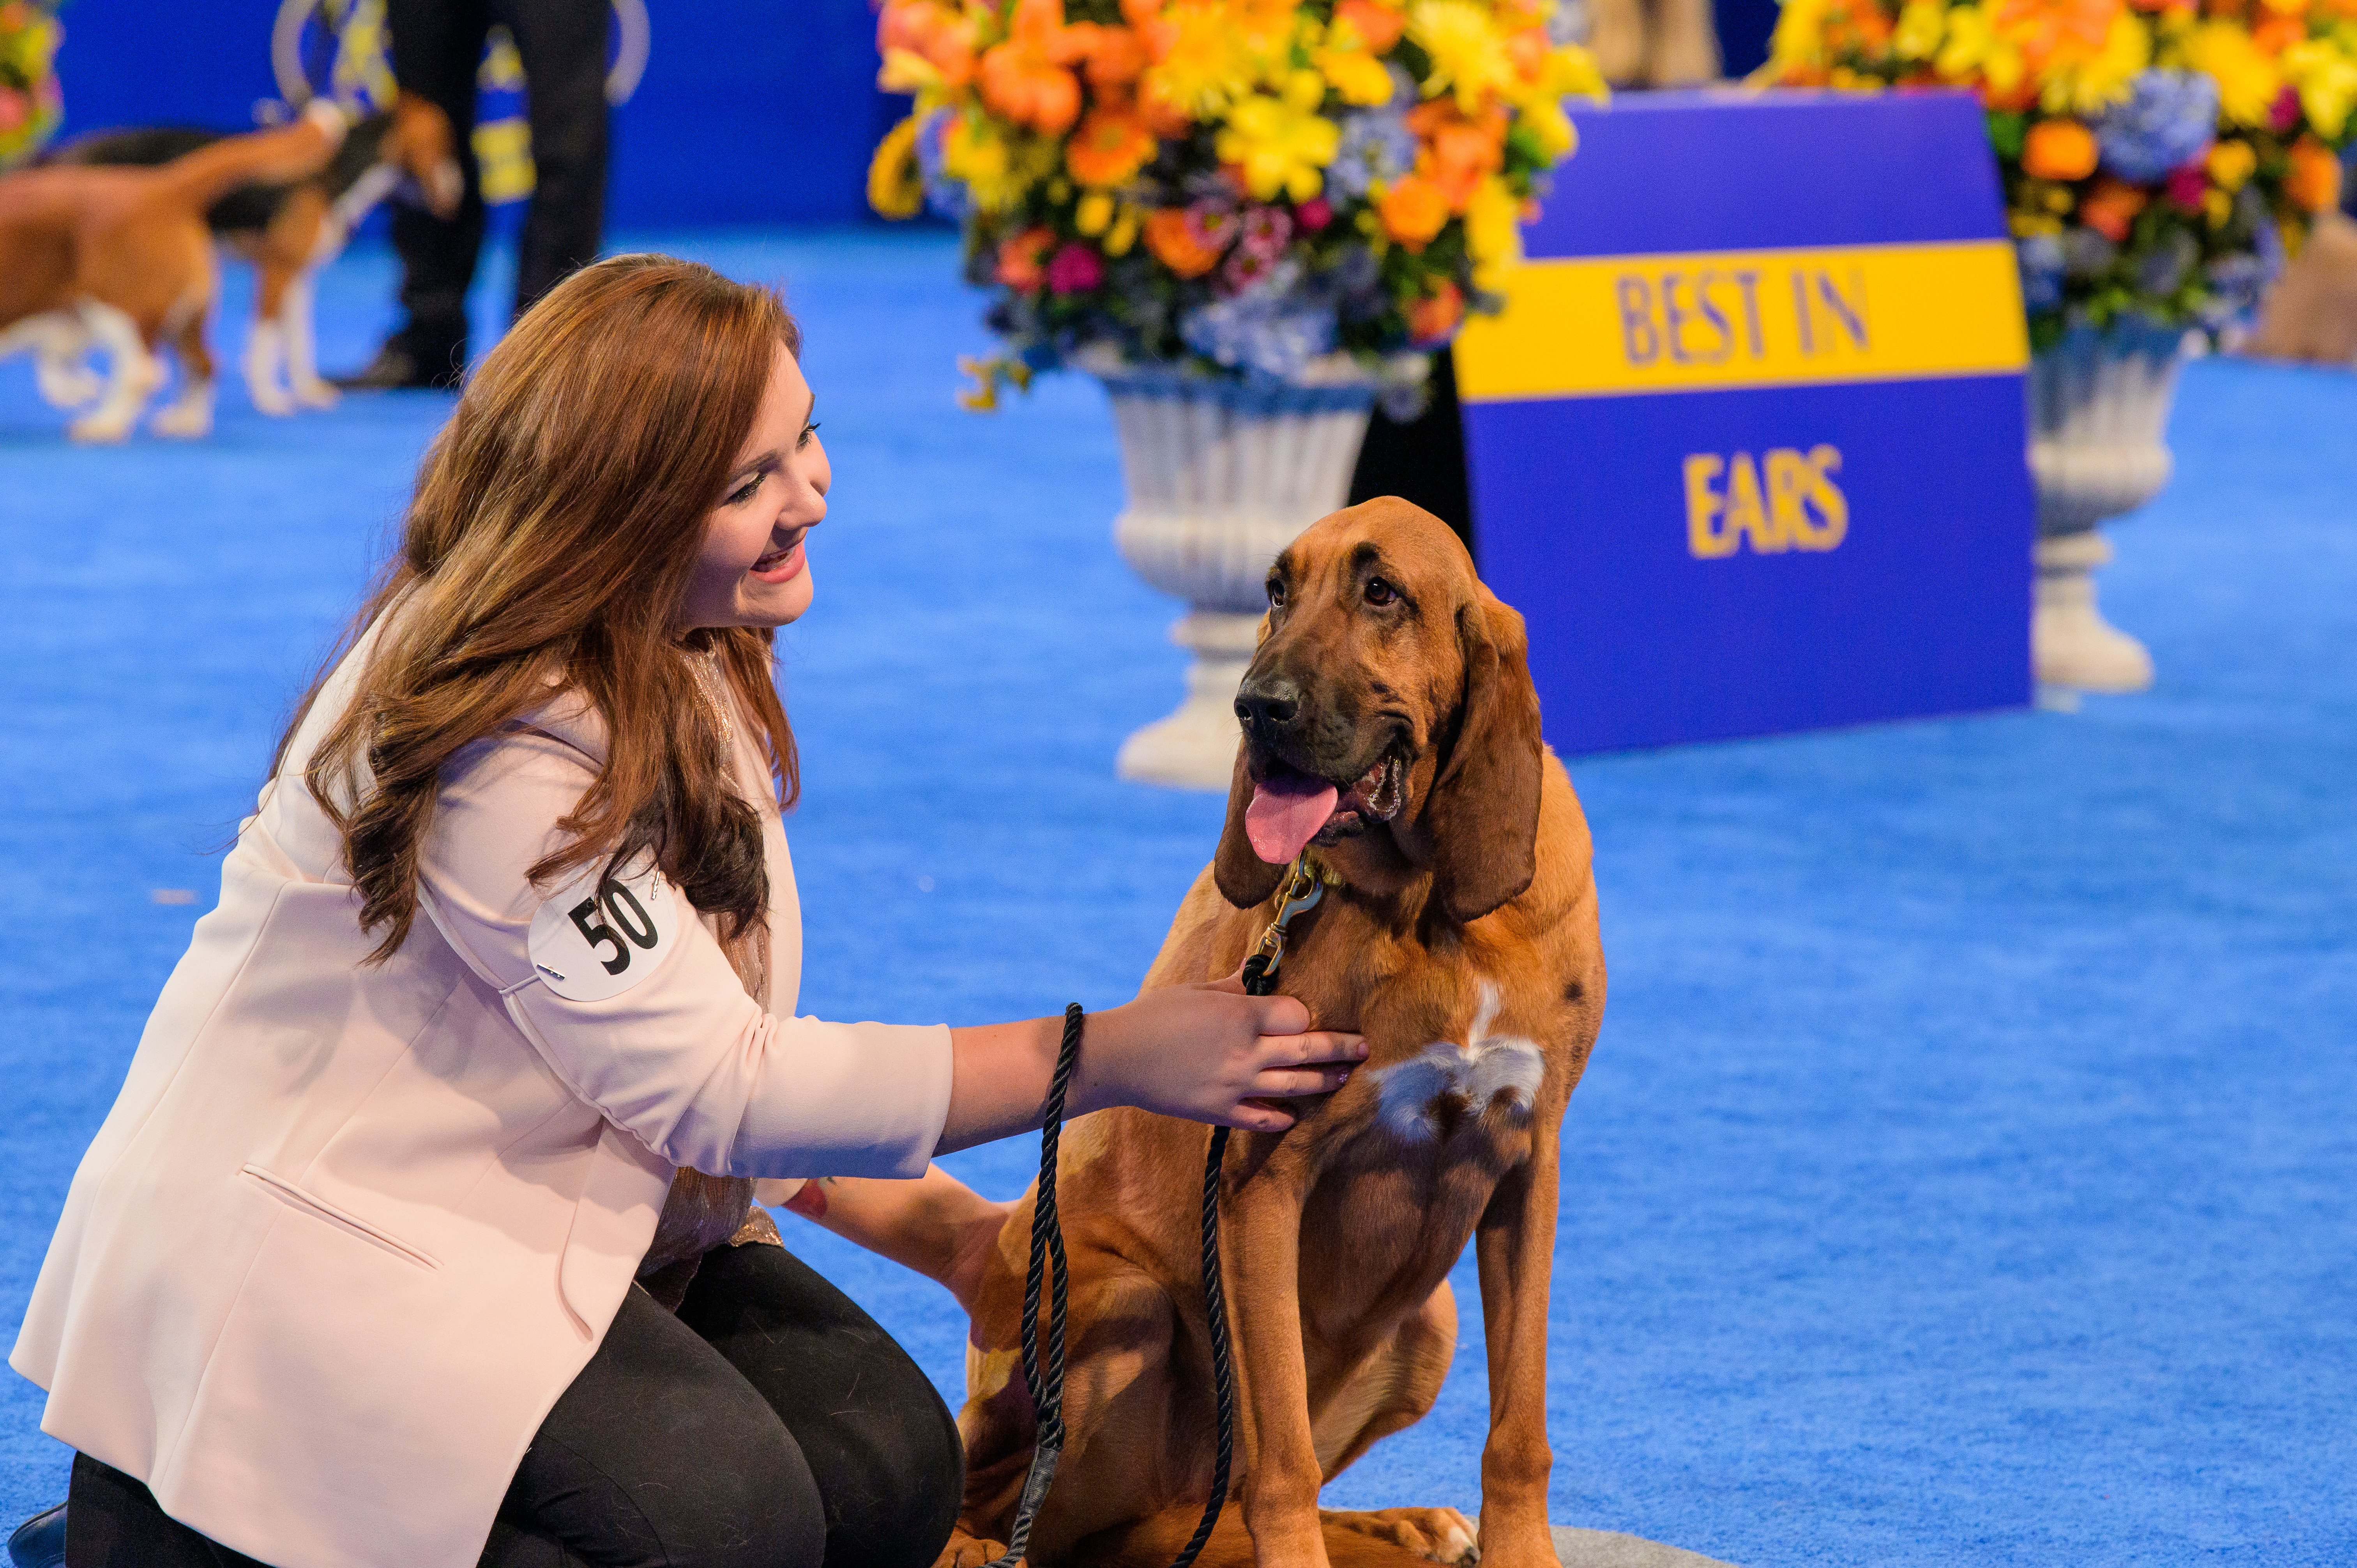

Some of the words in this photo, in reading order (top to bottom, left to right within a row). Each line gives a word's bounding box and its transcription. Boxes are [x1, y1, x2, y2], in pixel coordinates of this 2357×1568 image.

[1616, 268, 1765, 368] BEST
[1790, 266, 1872, 359] IN
[1684, 444, 1849, 558] EARS
[568, 879, 658, 975] 50
